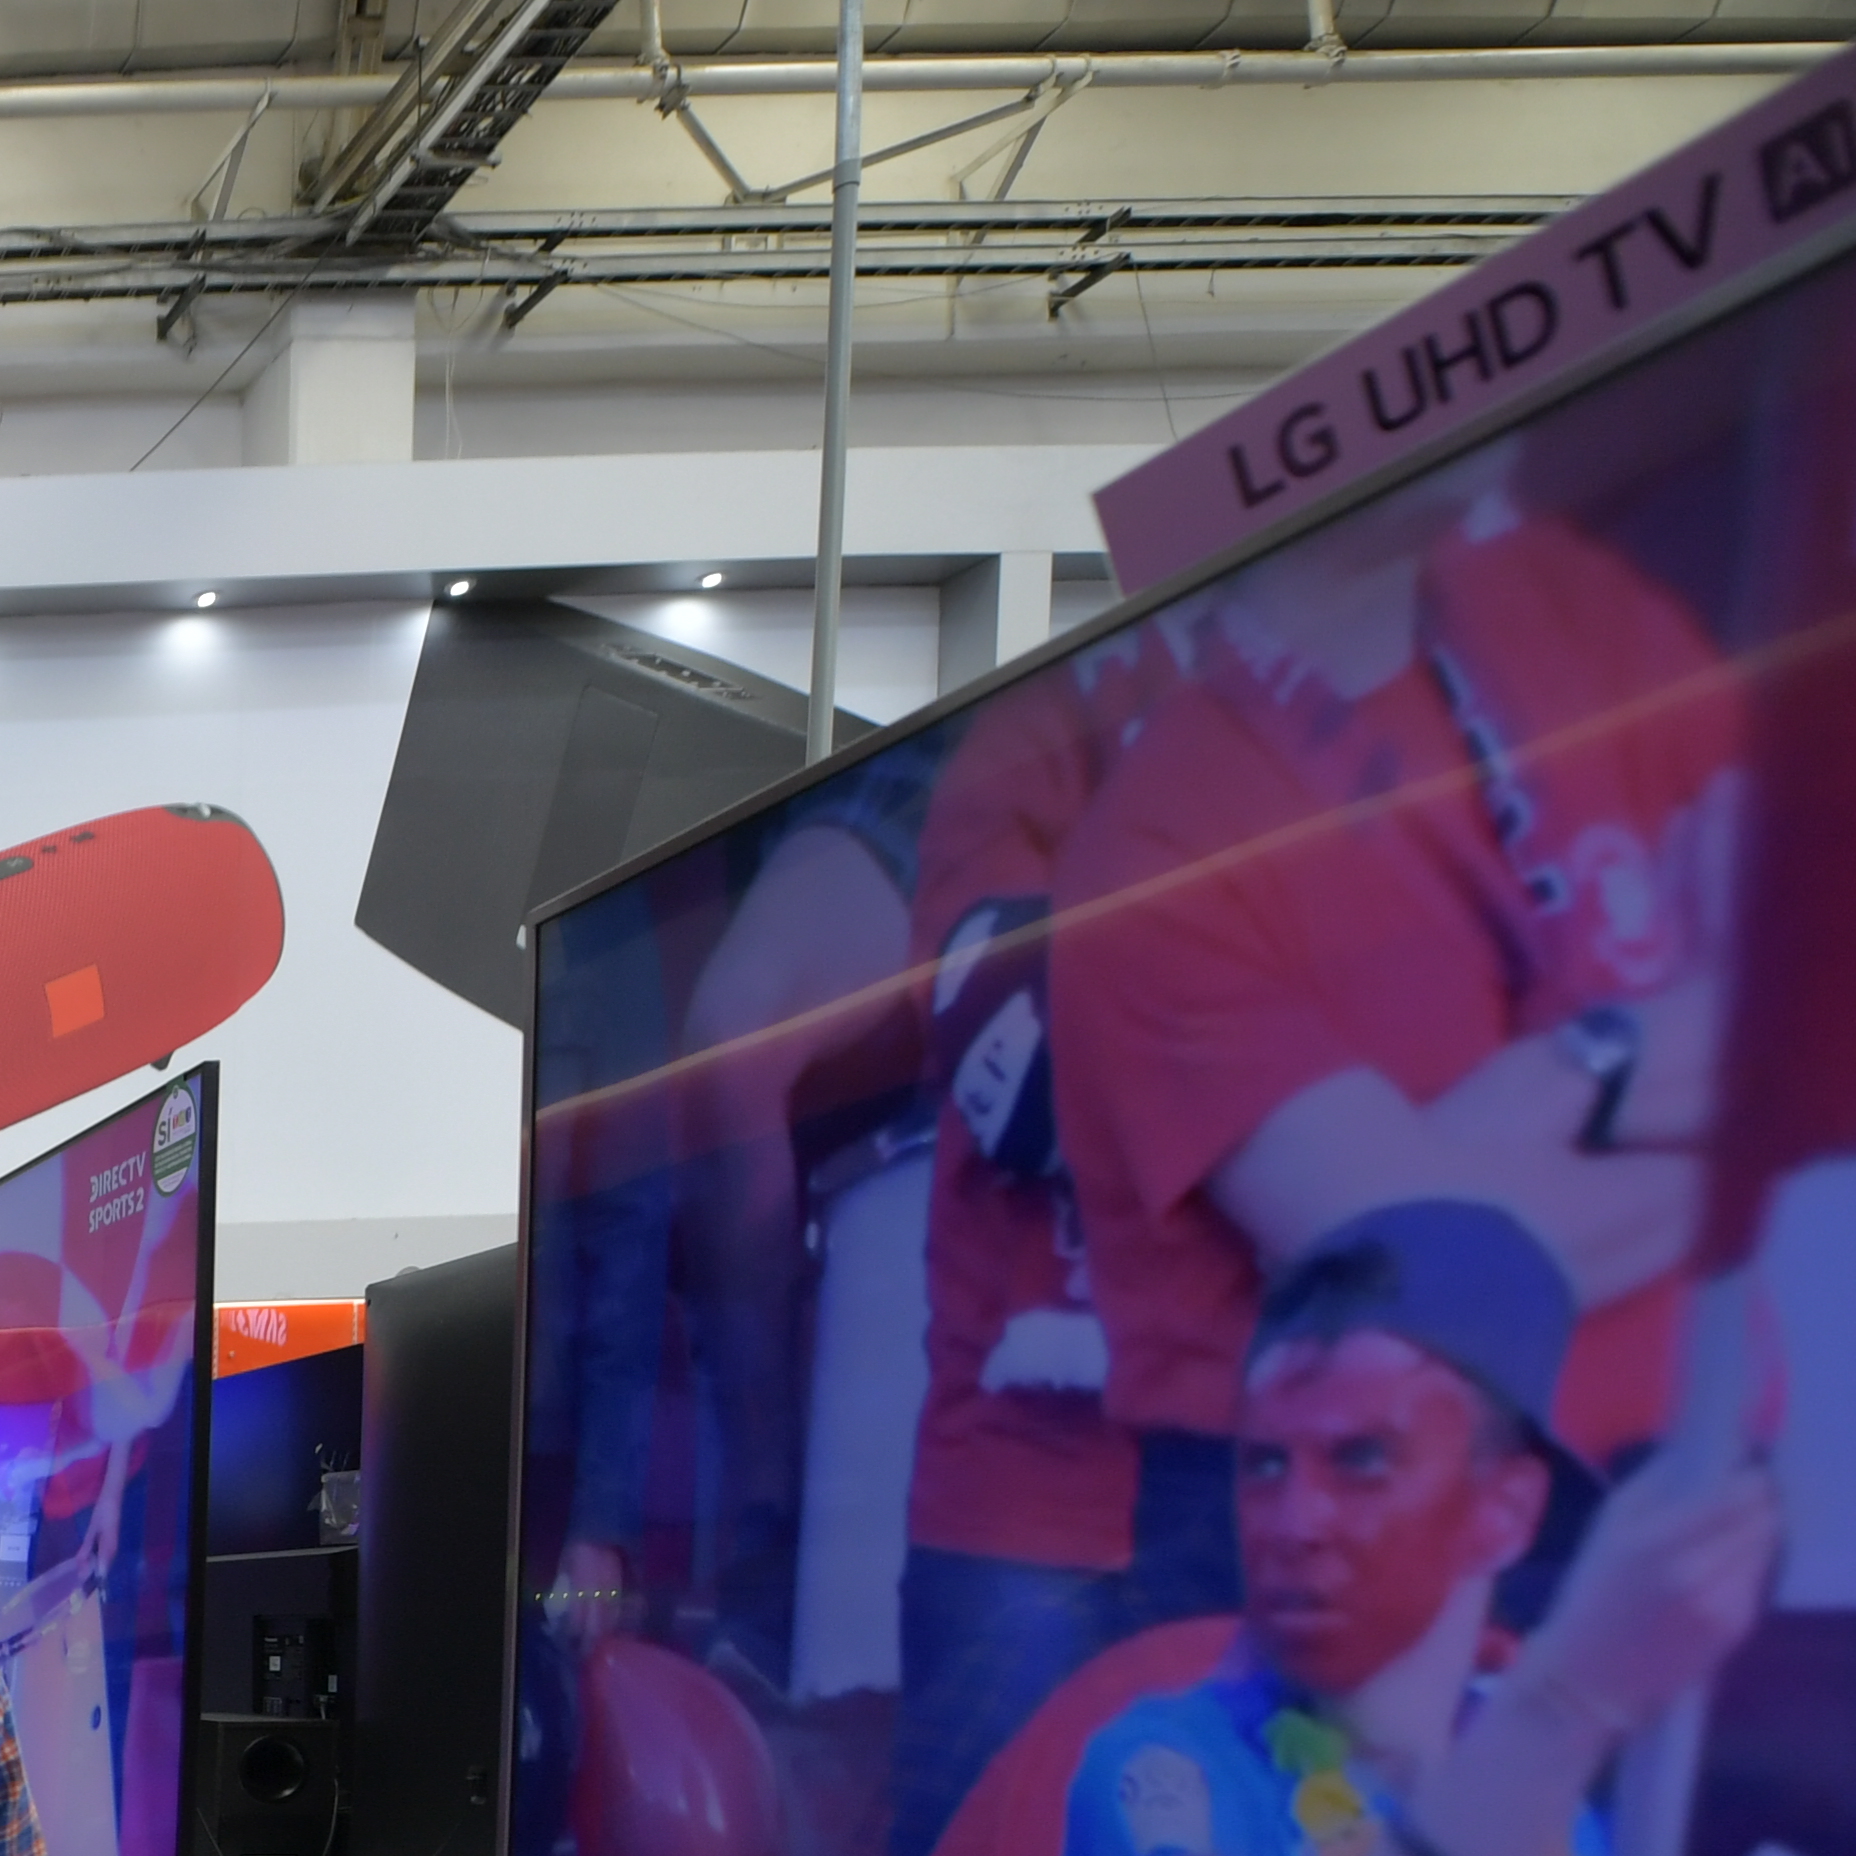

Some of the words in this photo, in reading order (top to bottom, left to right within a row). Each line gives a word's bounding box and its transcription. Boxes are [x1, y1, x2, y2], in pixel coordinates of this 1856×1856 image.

[1226, 404, 1340, 509] LG
[1362, 282, 1559, 434] UHD
[1573, 172, 1722, 310] TV
[90, 1152, 146, 1203] DIRECTV
[89, 1191, 134, 1234] SPORTS
[136, 1187, 145, 1212] 2
